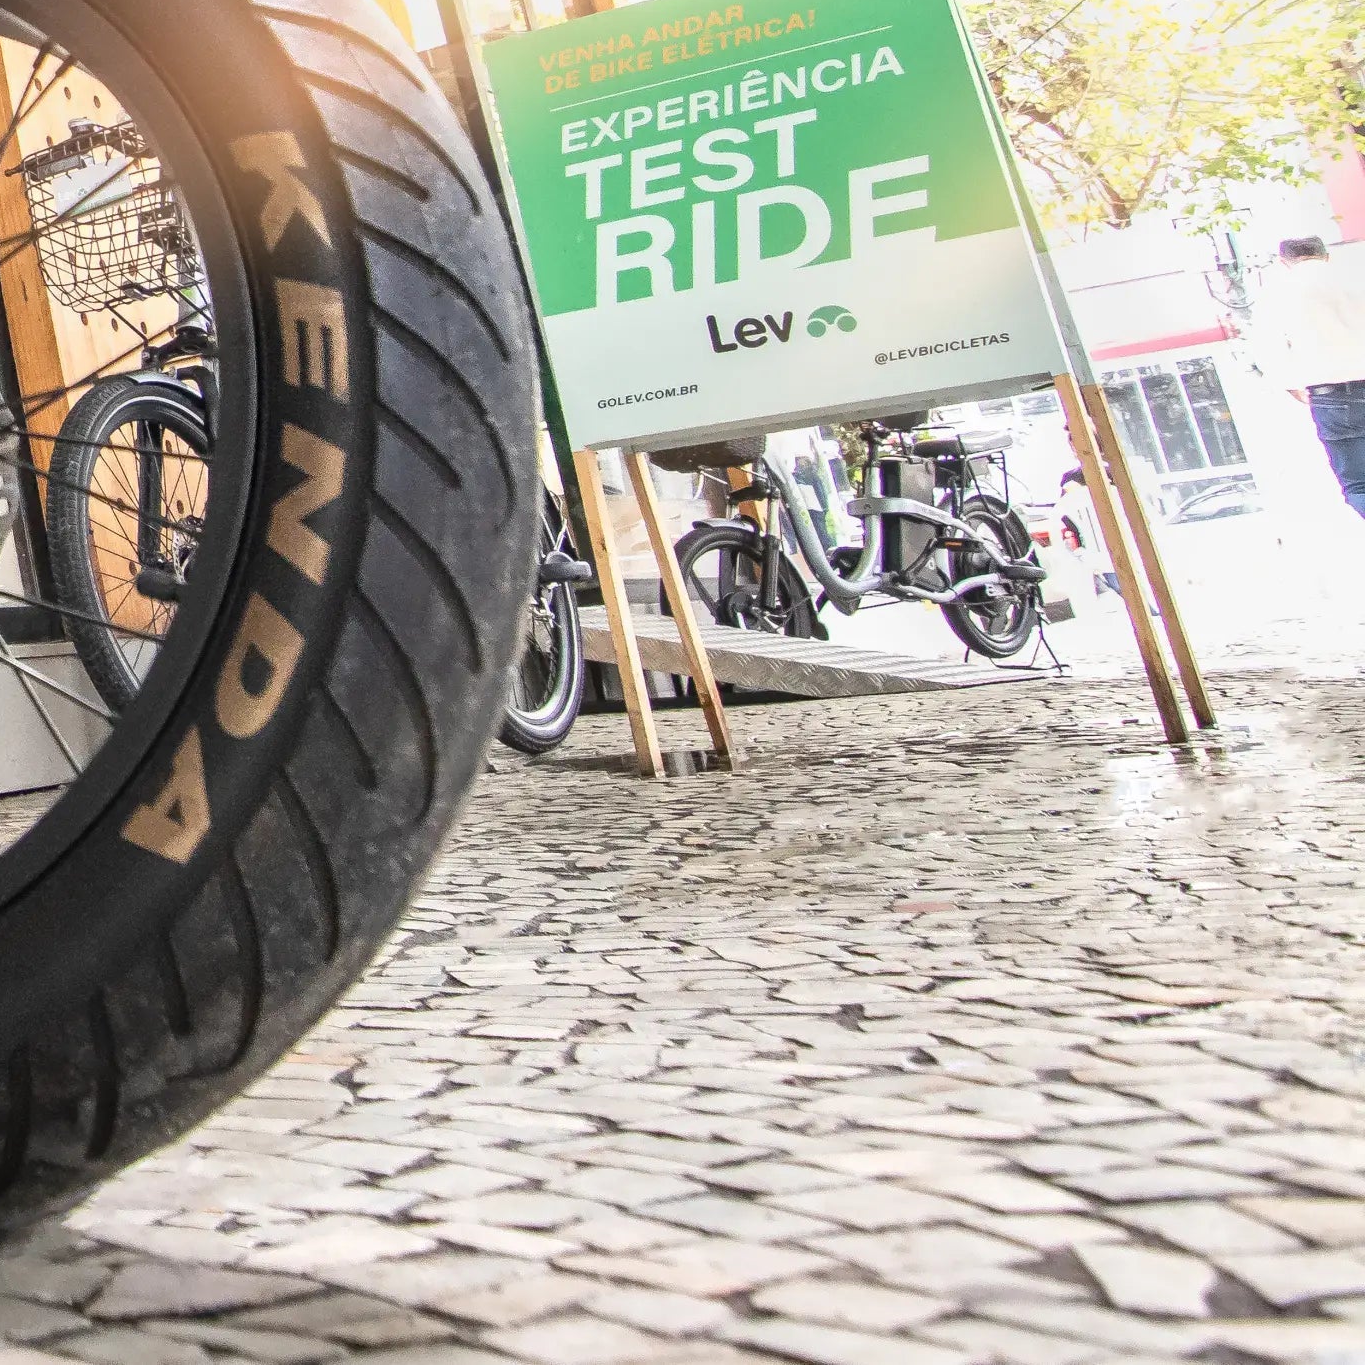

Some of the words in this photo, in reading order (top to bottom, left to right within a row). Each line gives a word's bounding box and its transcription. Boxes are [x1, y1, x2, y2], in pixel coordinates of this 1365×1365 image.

[539, 33, 635, 72] VENHA
[641, 4, 745, 47] ANDAR
[544, 68, 582, 95] DE
[589, 54, 654, 84] BIKE
[662, 9, 817, 65] ELÉTRICA!
[561, 45, 905, 154] EXPERIÊNCIA
[565, 108, 818, 220] TEST
[595, 154, 938, 307] RIDE
[706, 310, 794, 354] Lev
[874, 332, 1010, 366] @LEVBICICLETAS
[597, 383, 699, 410] GOLEV.COM.BR
[121, 130, 351, 864] KENDA
